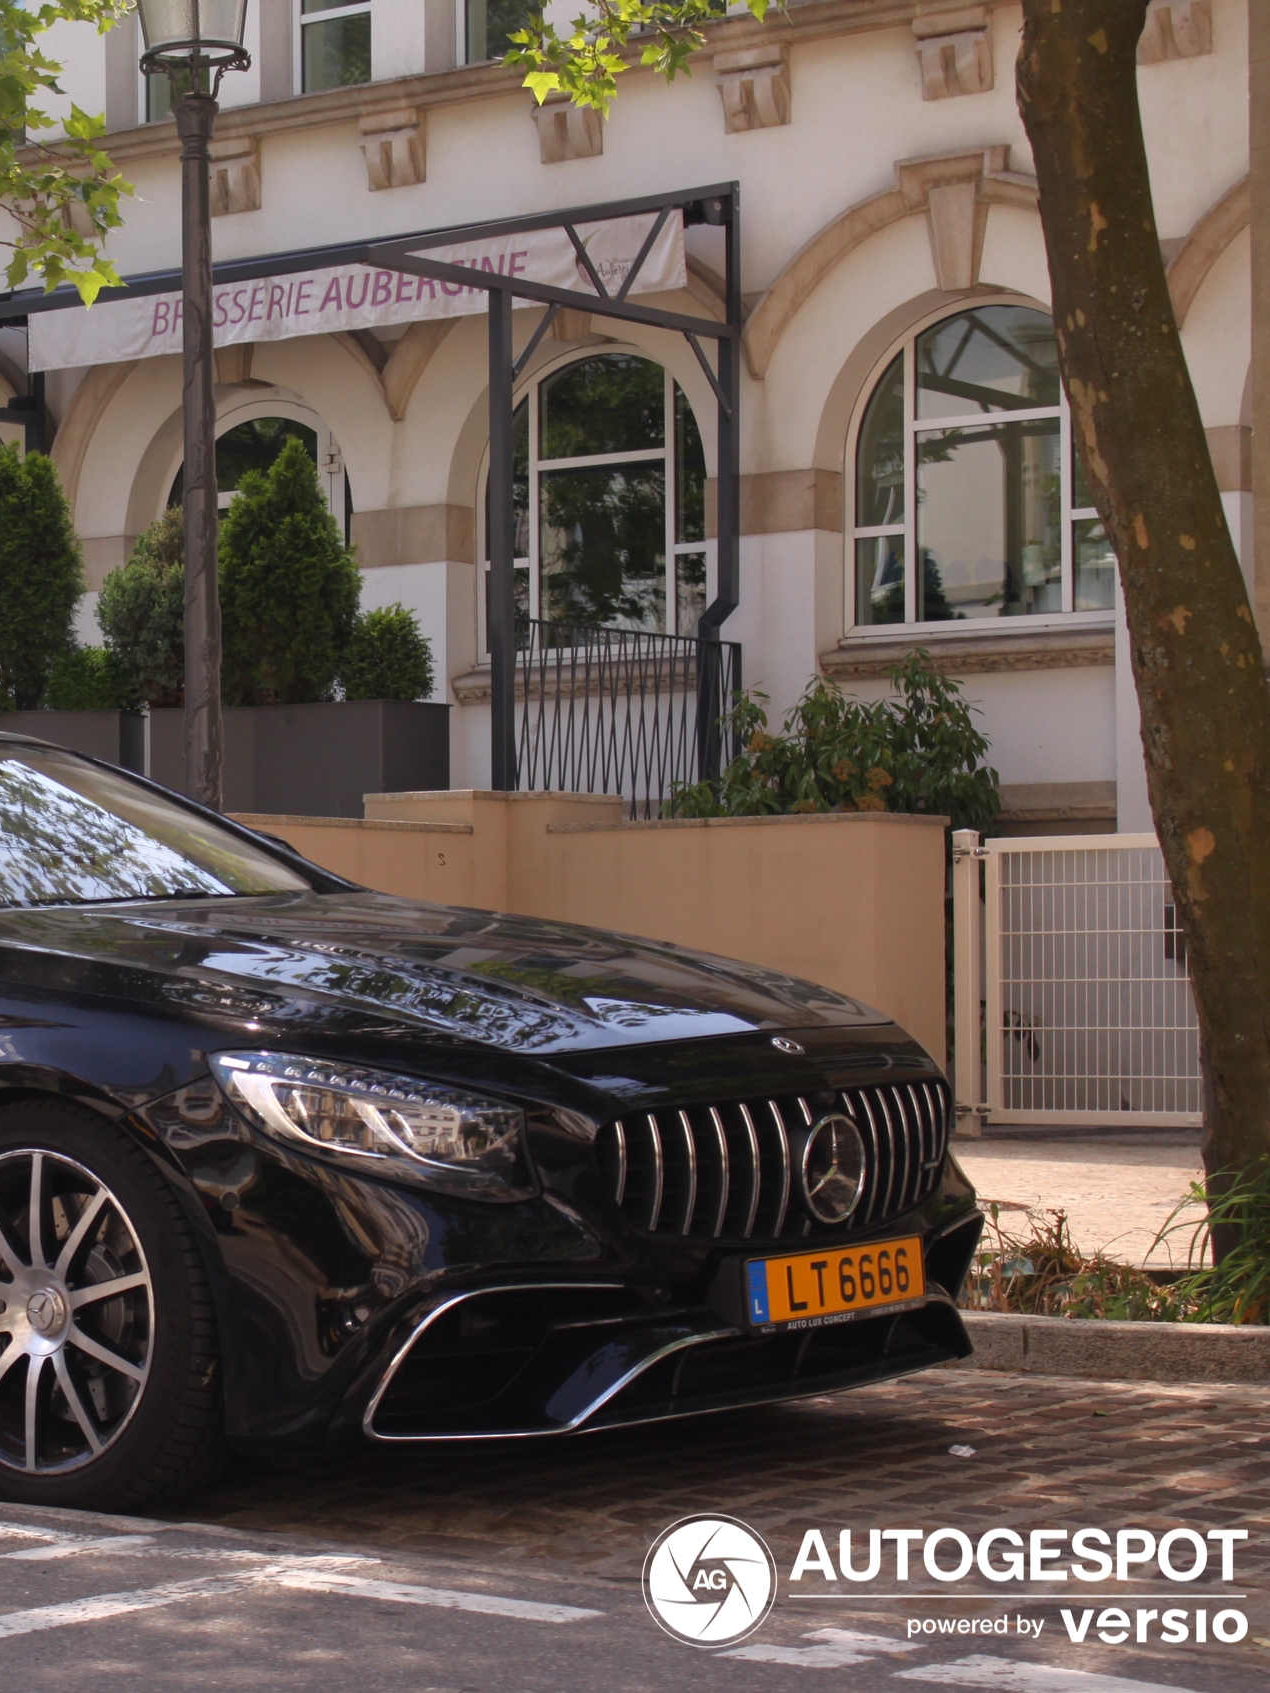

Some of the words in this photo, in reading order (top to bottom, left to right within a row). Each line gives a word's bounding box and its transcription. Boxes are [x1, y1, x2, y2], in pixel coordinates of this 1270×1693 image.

[151, 278, 315, 337] BRSSERIE
[786, 1260, 828, 1312] LT
[837, 1247, 910, 1303] 6666
[754, 1298, 764, 1315] L
[787, 1319, 807, 1330] AUTO
[808, 1317, 822, 1327] LUX
[823, 1312, 856, 1325] CONCEPT
